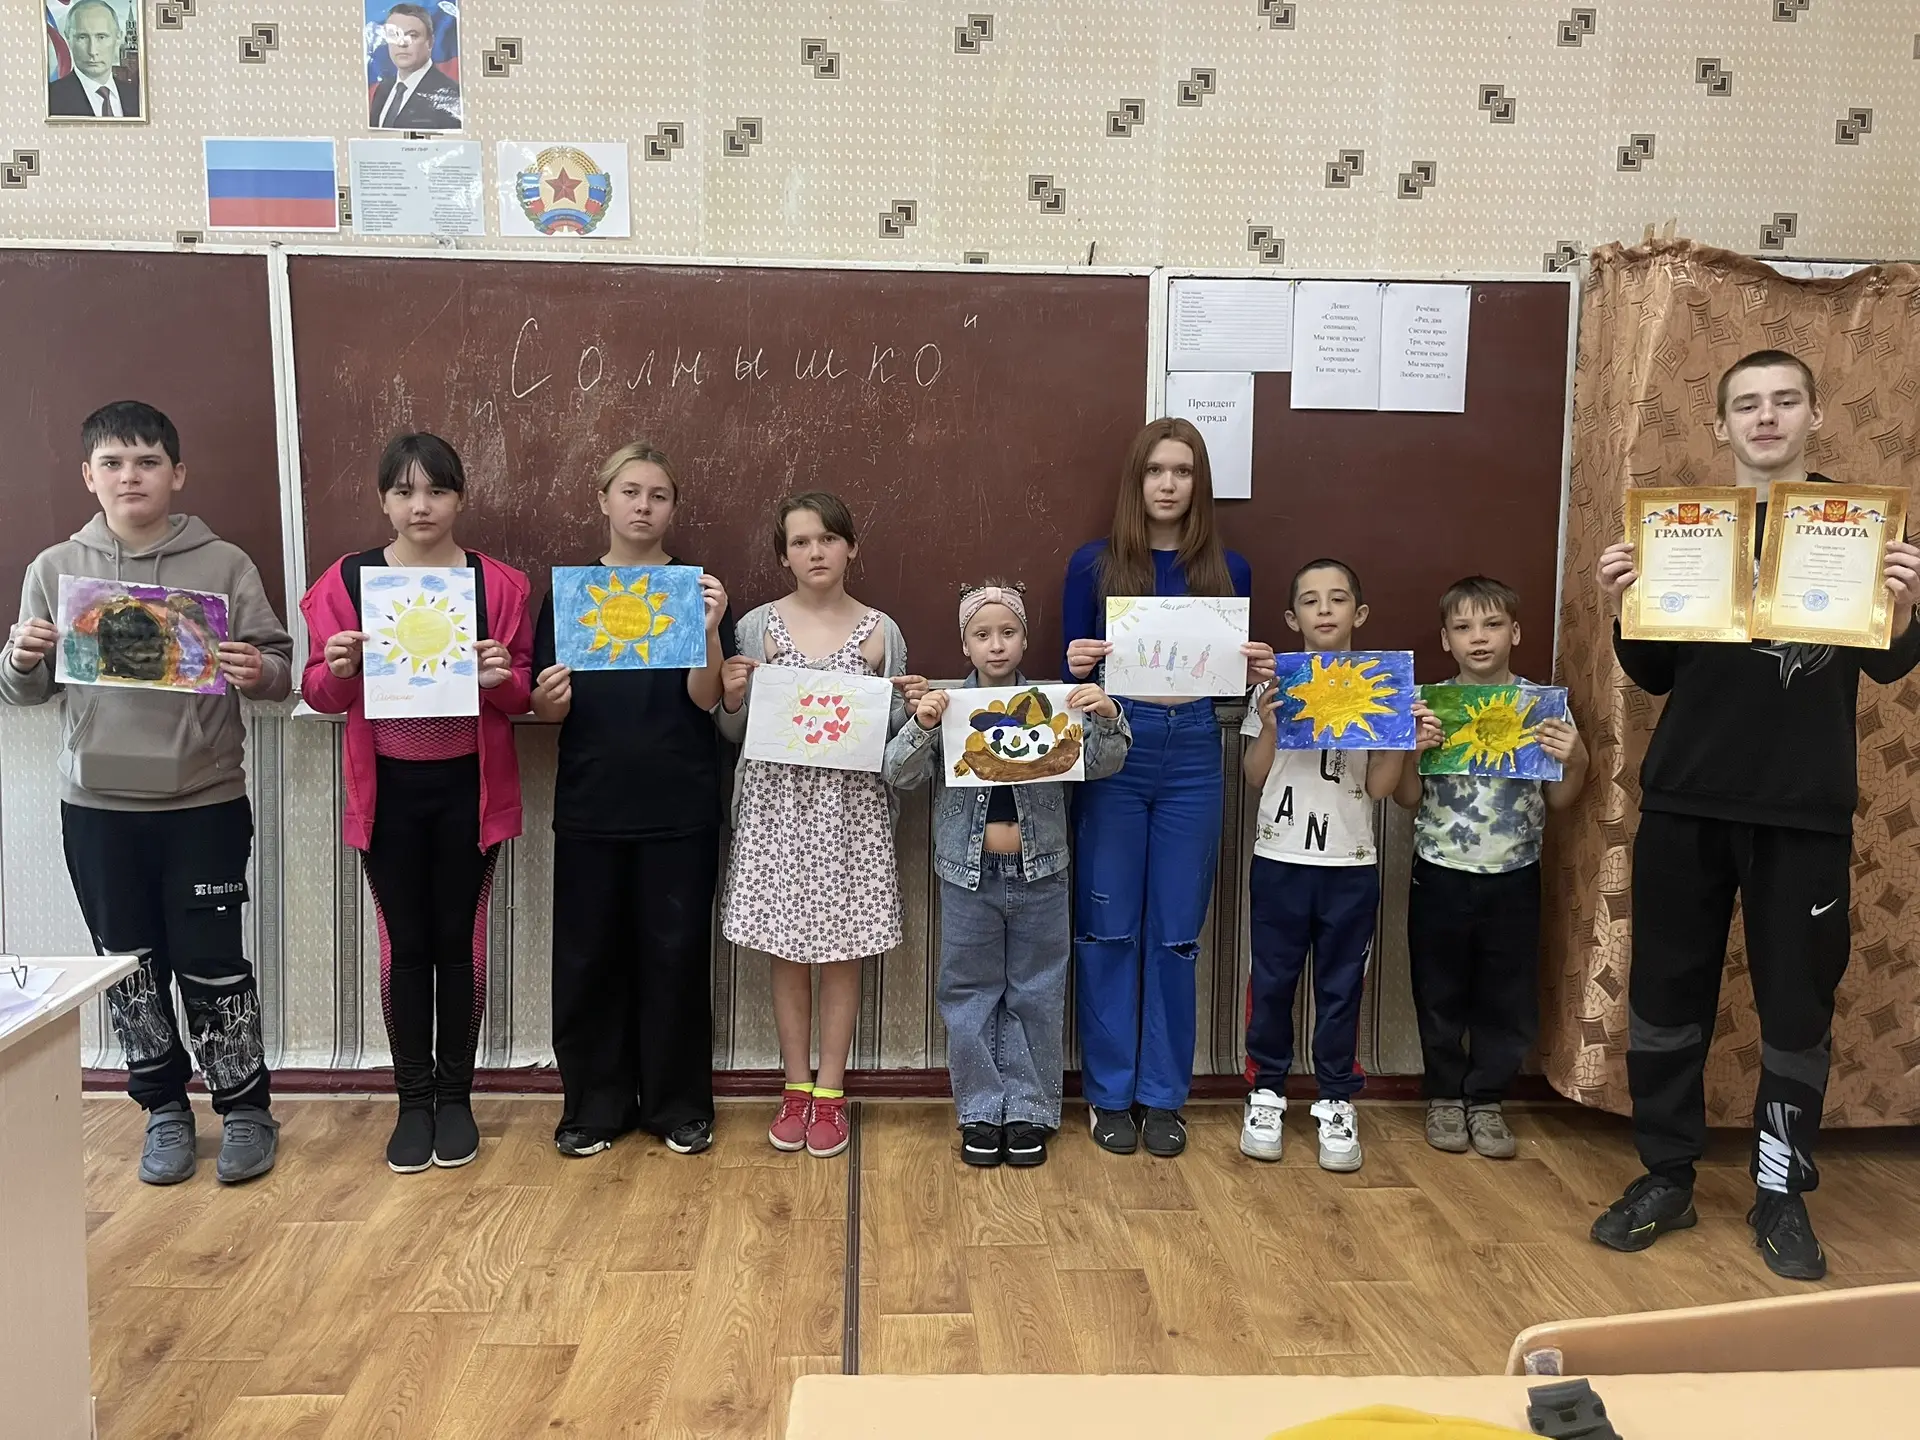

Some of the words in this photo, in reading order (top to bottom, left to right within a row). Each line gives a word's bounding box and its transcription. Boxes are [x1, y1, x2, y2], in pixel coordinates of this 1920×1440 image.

[1188, 398, 1236, 409] Президент
[1196, 414, 1227, 423] отряда
[1654, 527, 1723, 539] ГРАМОТА
[1795, 524, 1869, 538] ГРАМОТА
